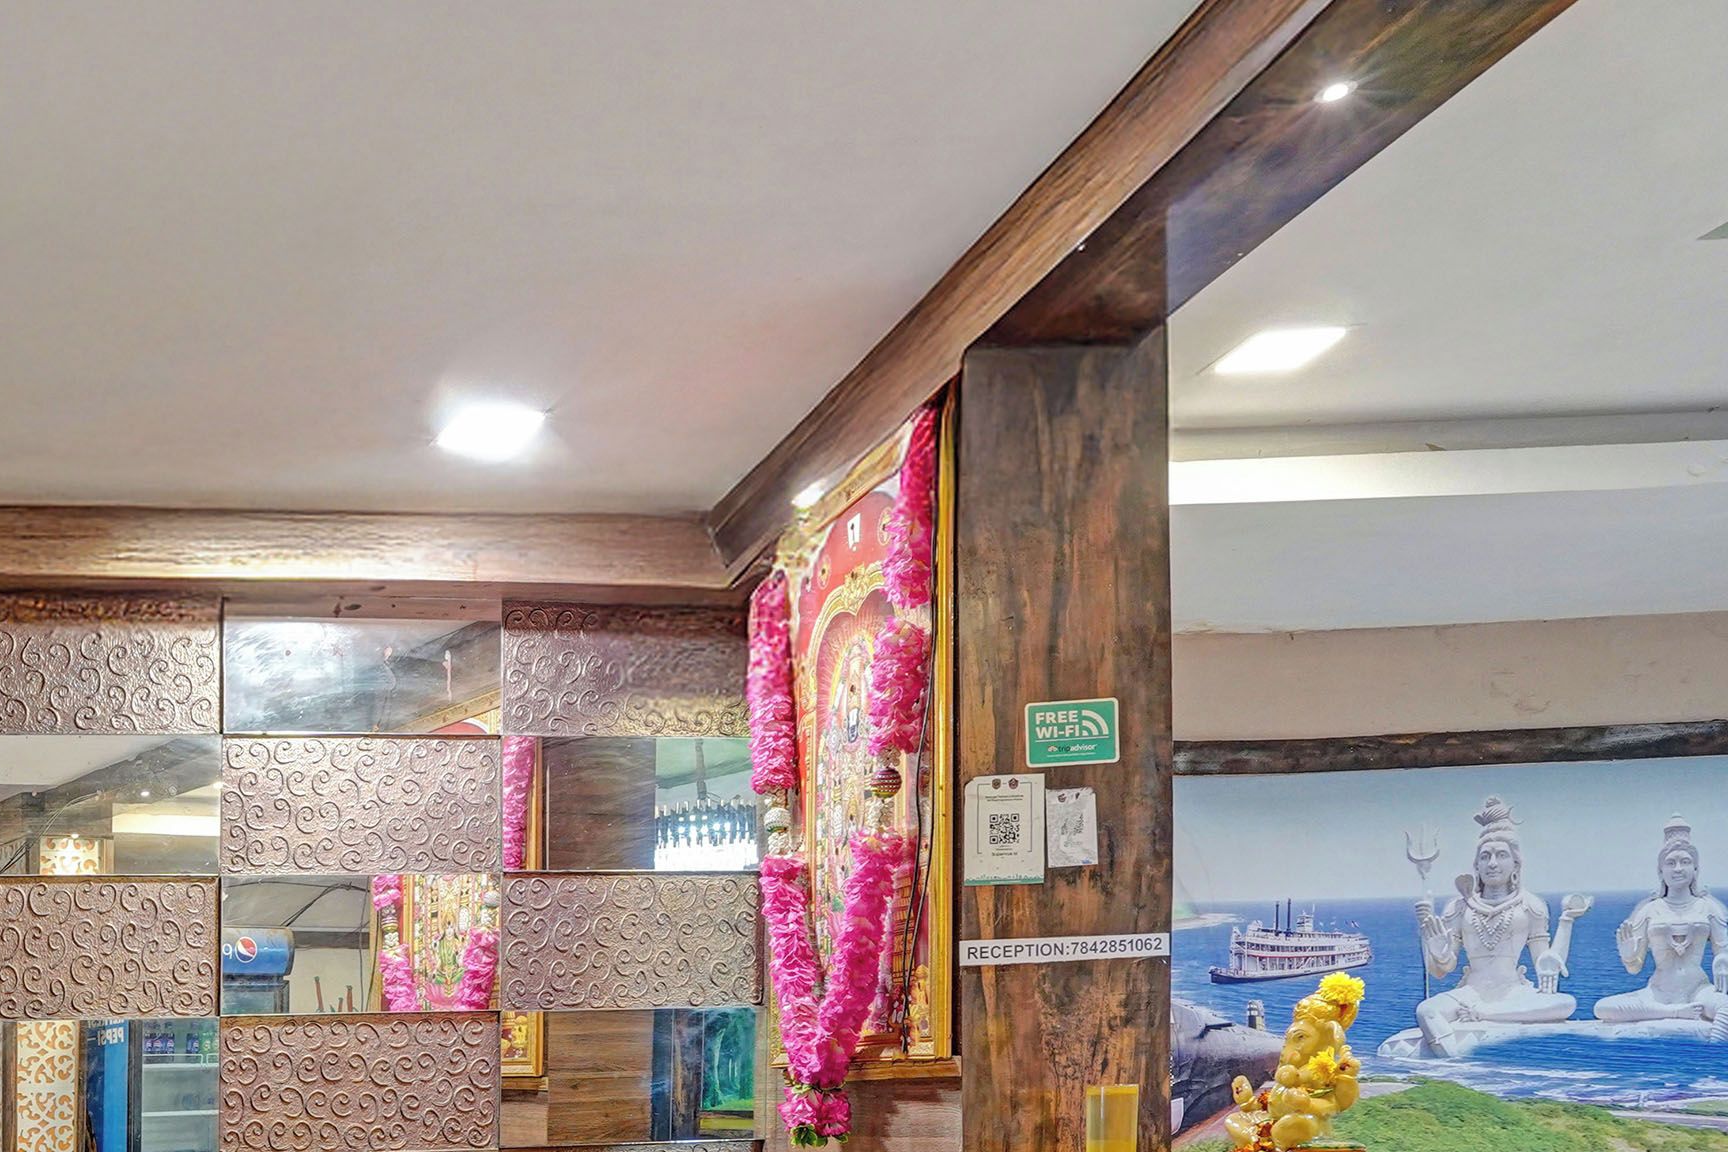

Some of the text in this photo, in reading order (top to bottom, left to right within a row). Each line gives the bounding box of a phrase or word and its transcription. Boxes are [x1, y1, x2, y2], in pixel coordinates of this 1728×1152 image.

[1035, 710, 1078, 725] FREE
[1035, 725, 1080, 739] WI-FI
[967, 937, 1162, 960] RECEPTION:7842851062
